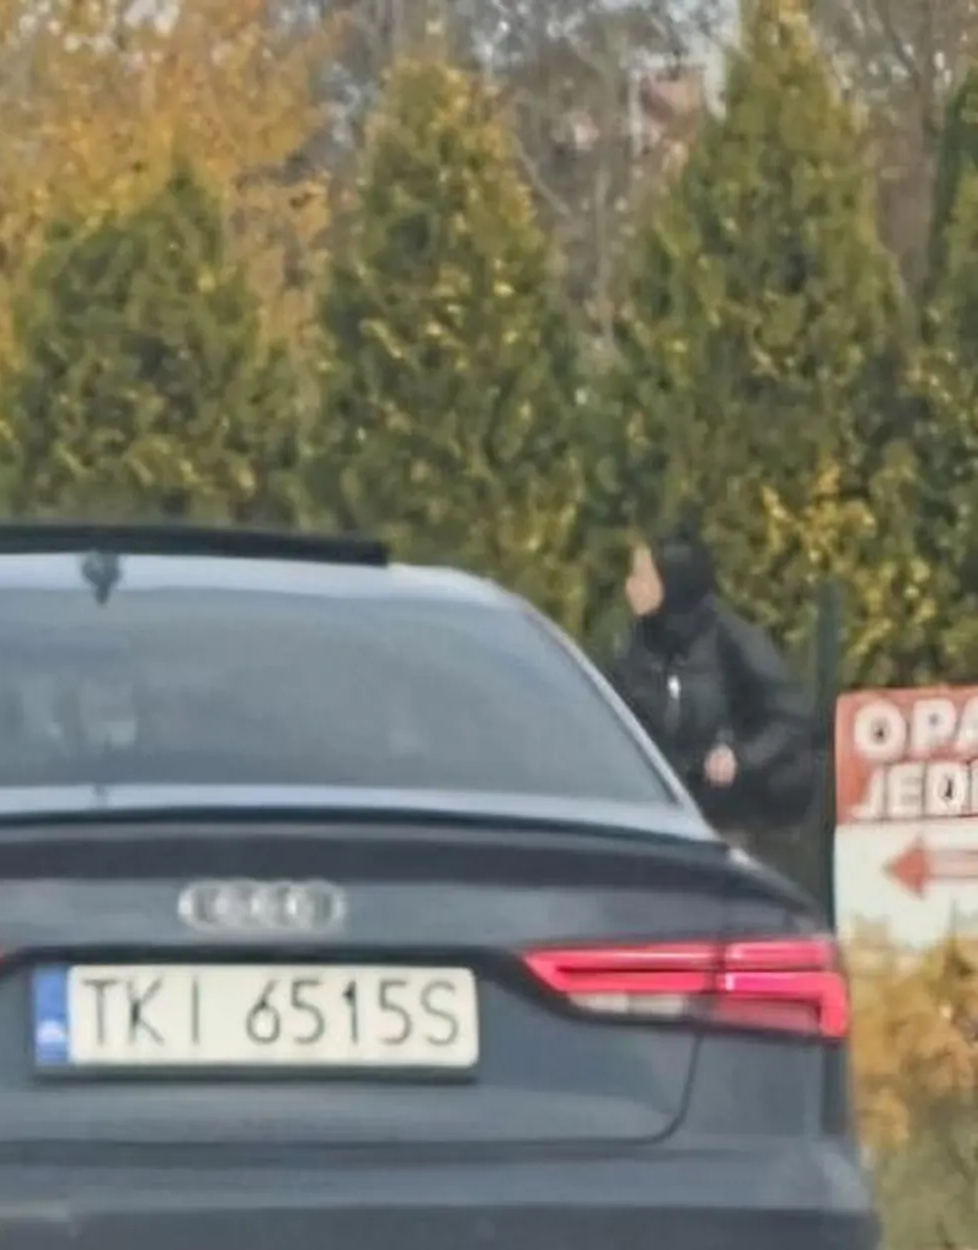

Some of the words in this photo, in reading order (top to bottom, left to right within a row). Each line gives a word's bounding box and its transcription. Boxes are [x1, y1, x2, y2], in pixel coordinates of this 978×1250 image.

[851, 760, 978, 820] JED
[82, 977, 200, 1046] TKI
[245, 978, 460, 1048] 6515S
